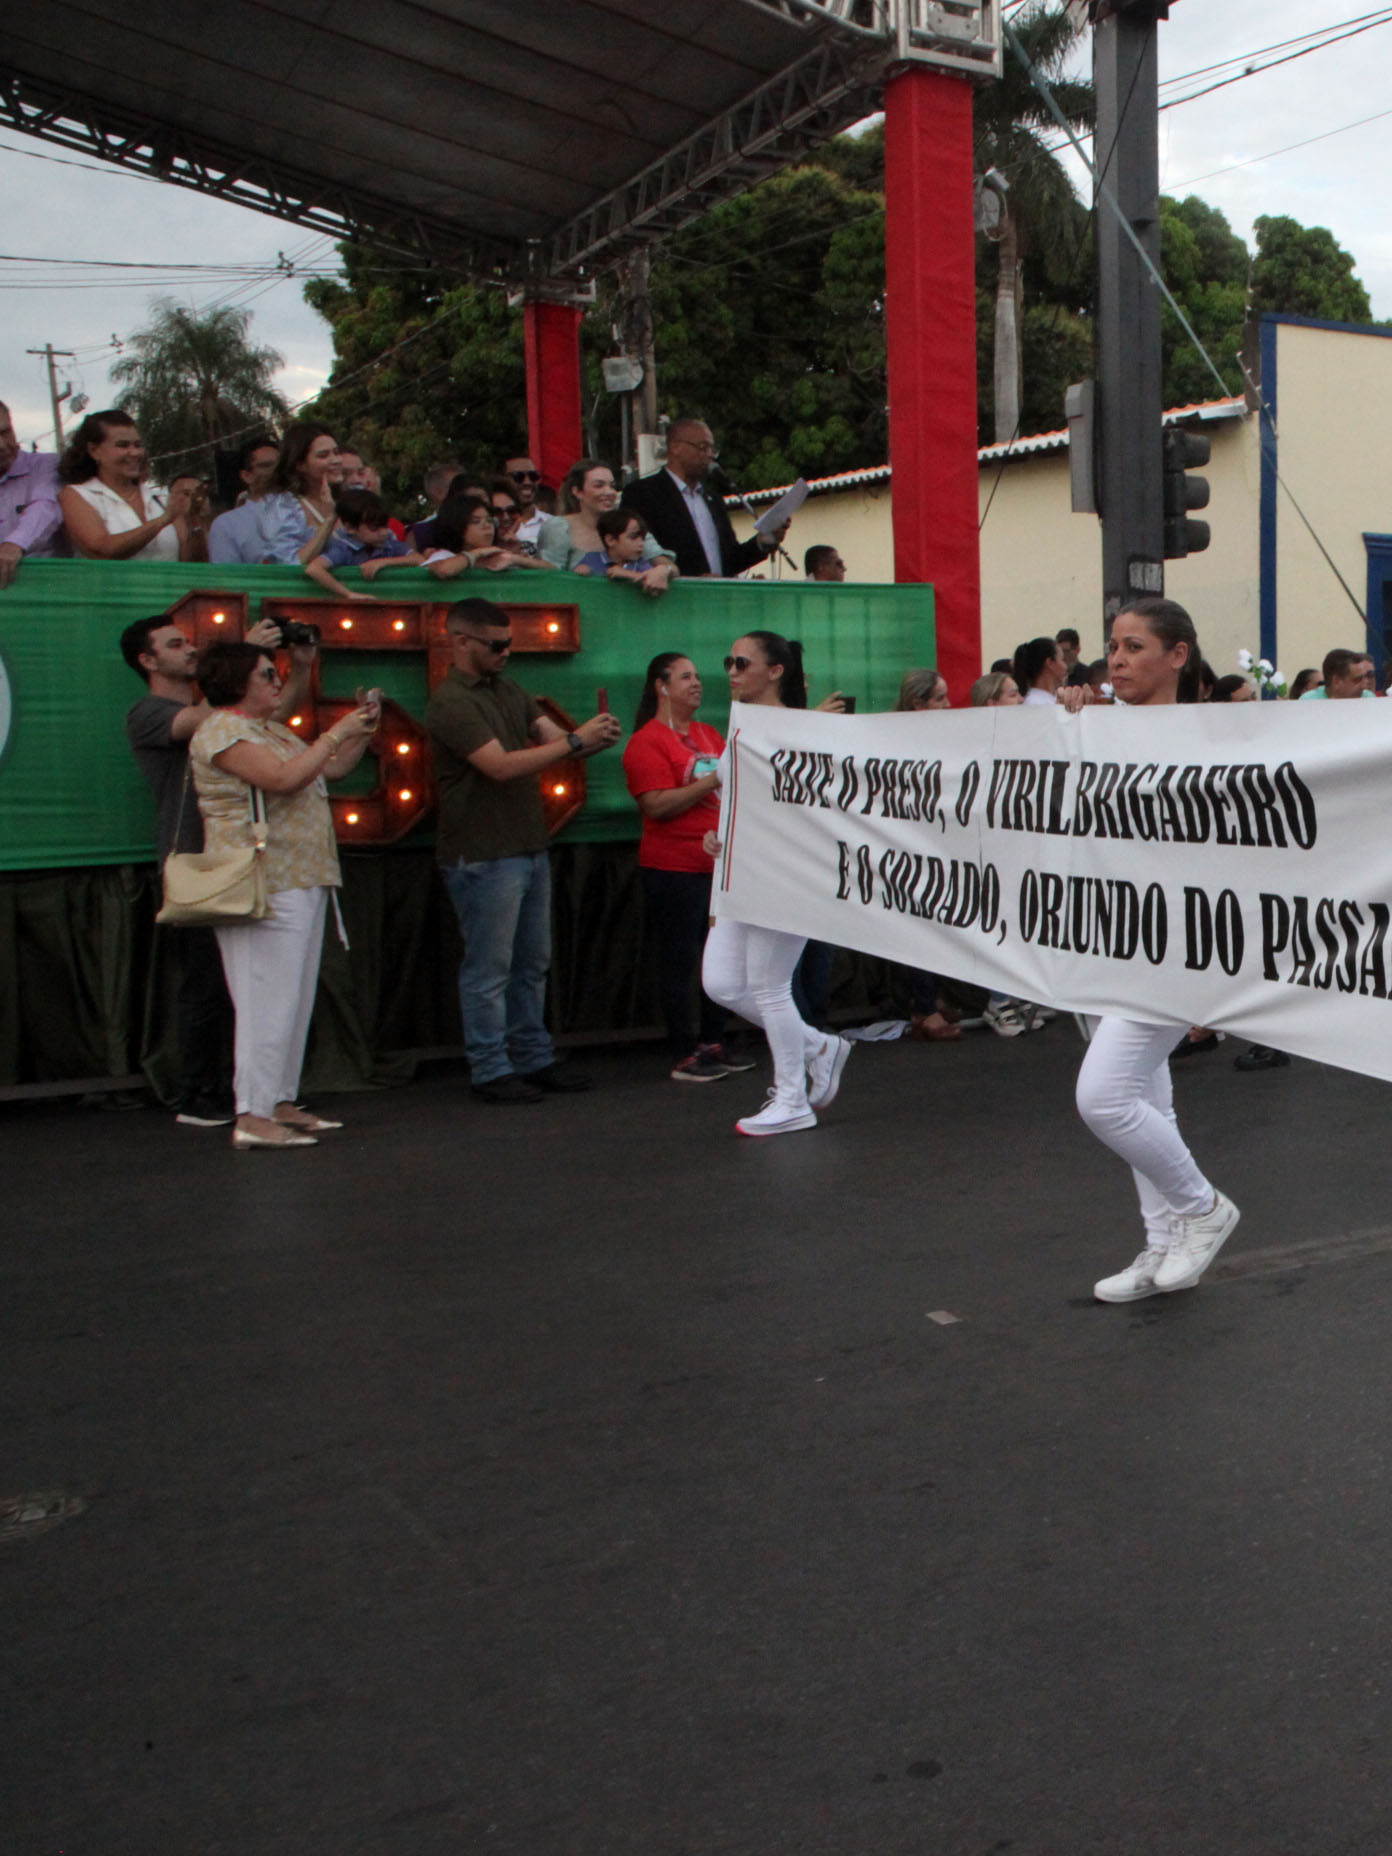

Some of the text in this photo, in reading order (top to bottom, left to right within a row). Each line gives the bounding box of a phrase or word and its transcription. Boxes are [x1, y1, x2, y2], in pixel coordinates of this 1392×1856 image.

[769, 749, 835, 808] SALVE
[837, 755, 858, 812] O
[861, 757, 946, 834] PRESO,
[955, 760, 981, 828] O
[836, 840, 850, 900] E
[857, 844, 873, 905] O
[879, 849, 1007, 946] SOLDADO,
[1019, 868, 1168, 966] ORIUNDO
[1184, 886, 1245, 977] DO
